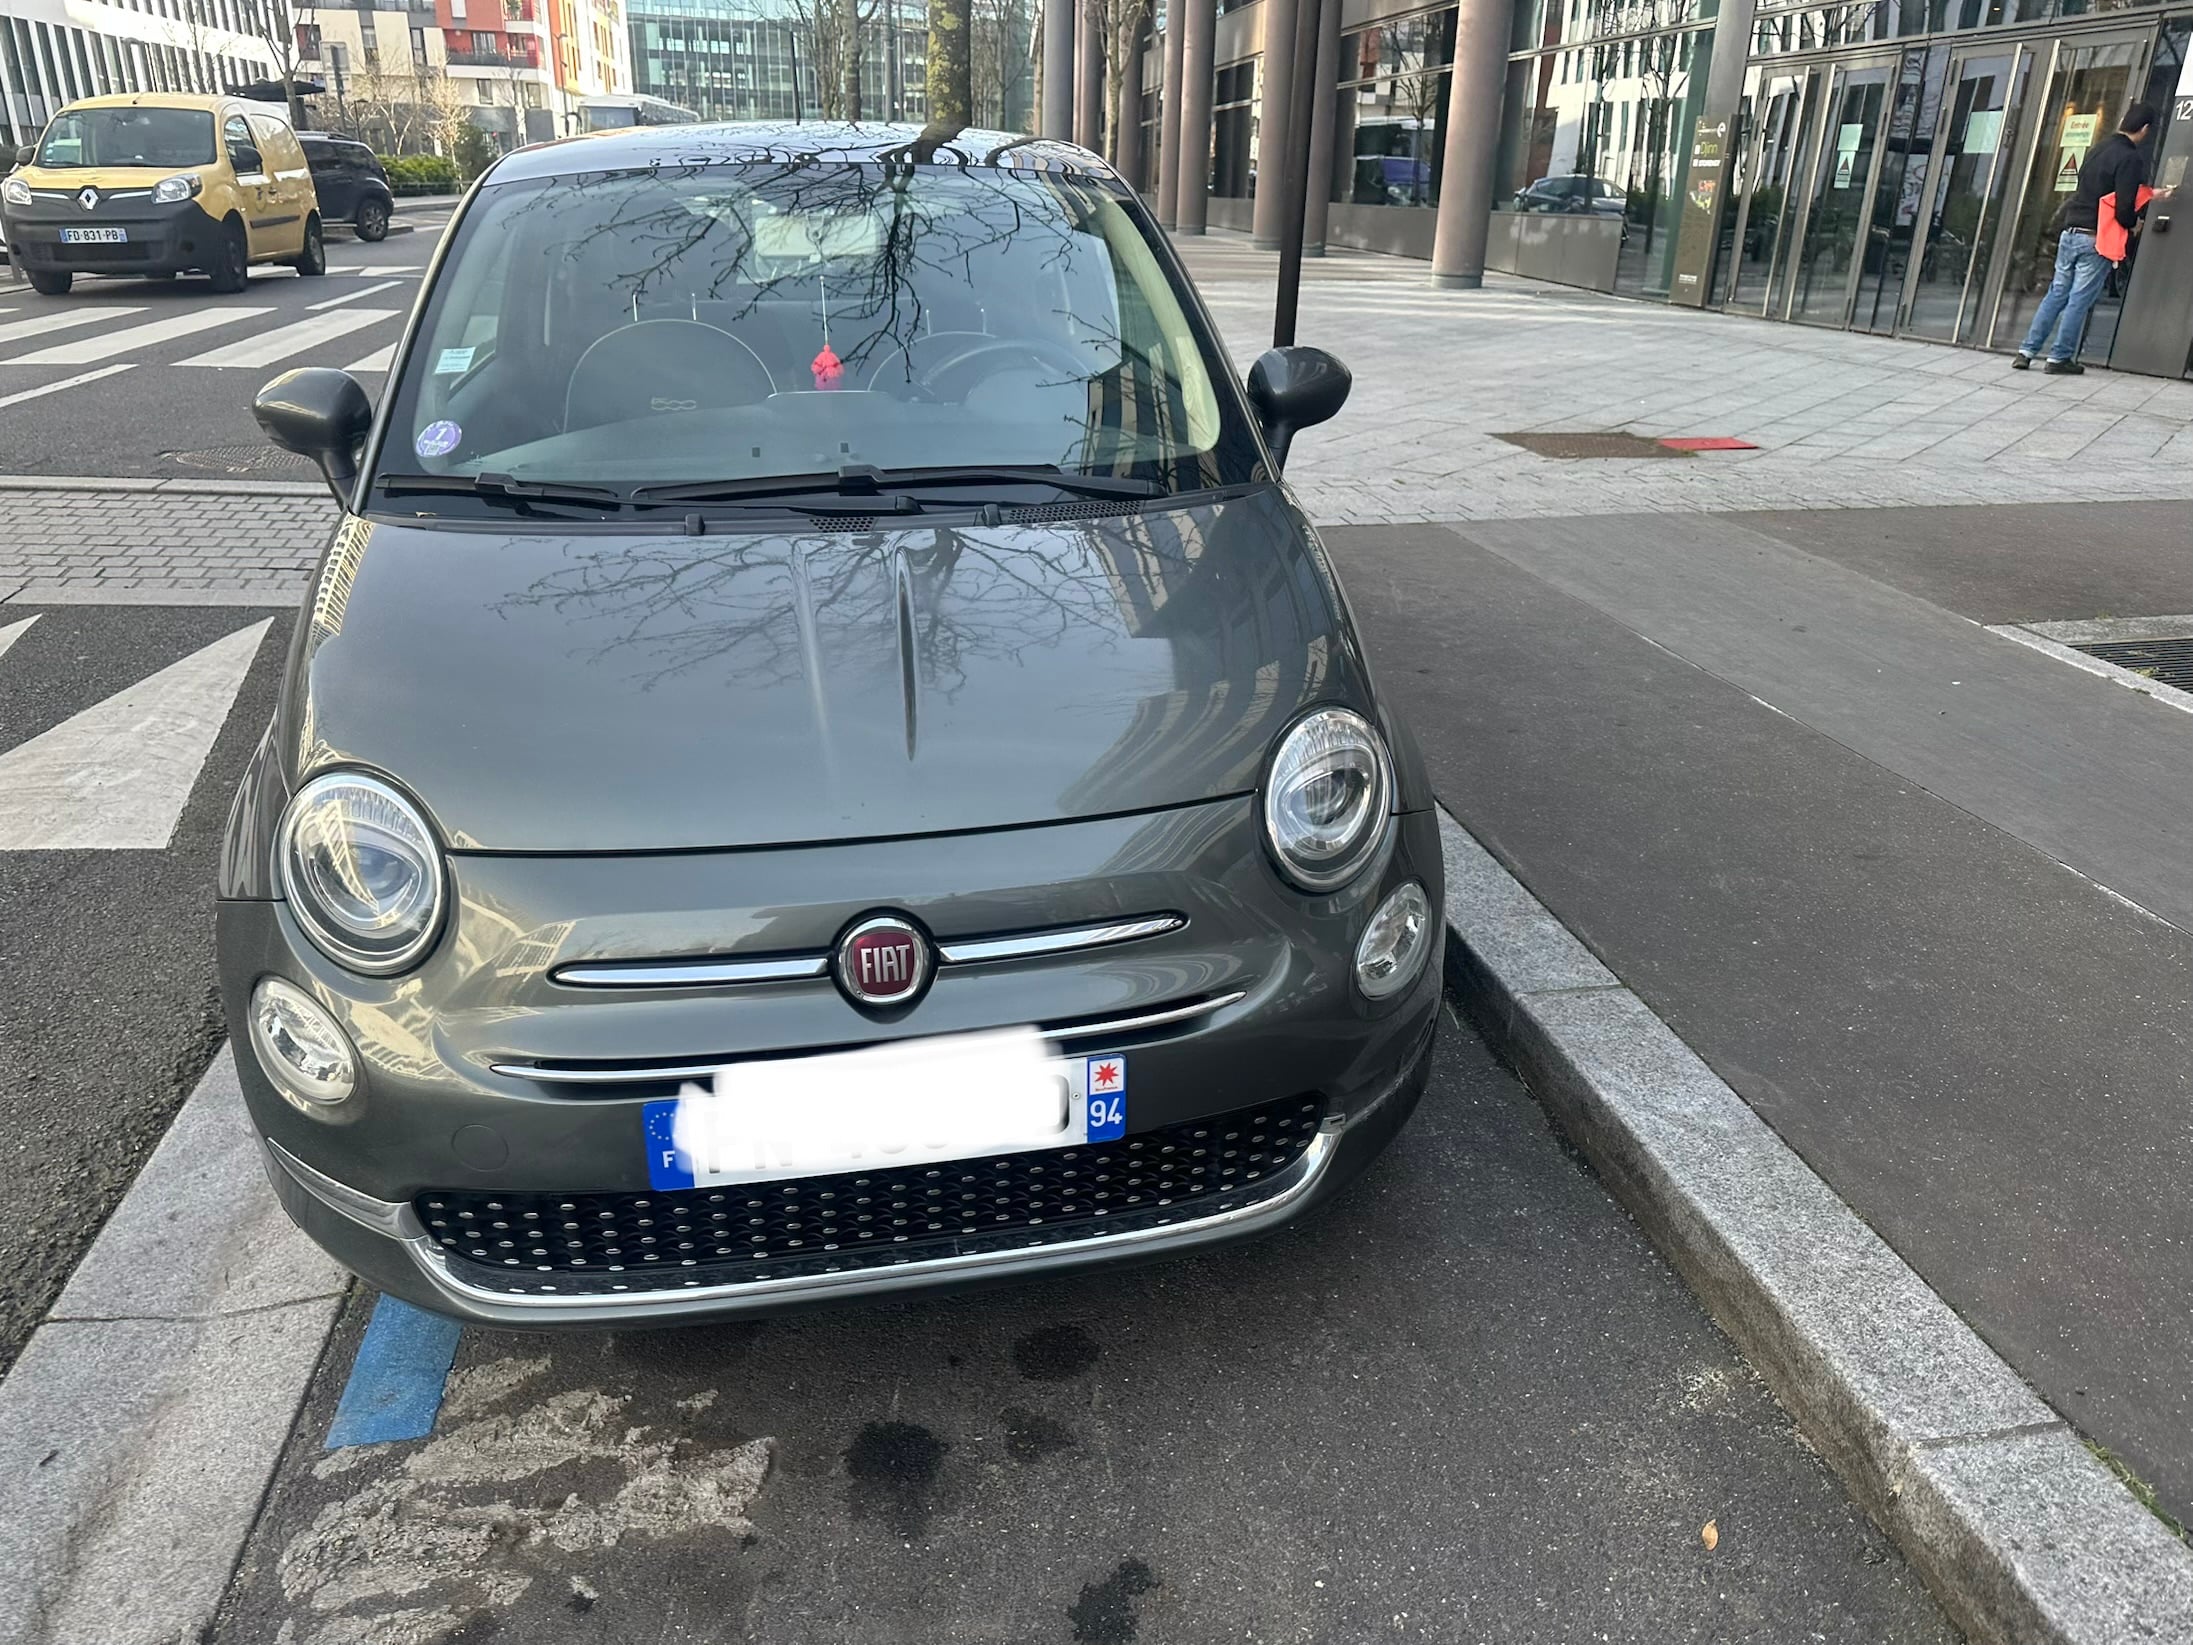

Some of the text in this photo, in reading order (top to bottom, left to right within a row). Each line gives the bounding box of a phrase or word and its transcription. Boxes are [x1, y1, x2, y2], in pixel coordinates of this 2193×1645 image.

[860, 944, 911, 984] FIAT
[1090, 1097, 1123, 1128] 94
[662, 1150, 676, 1169] F
